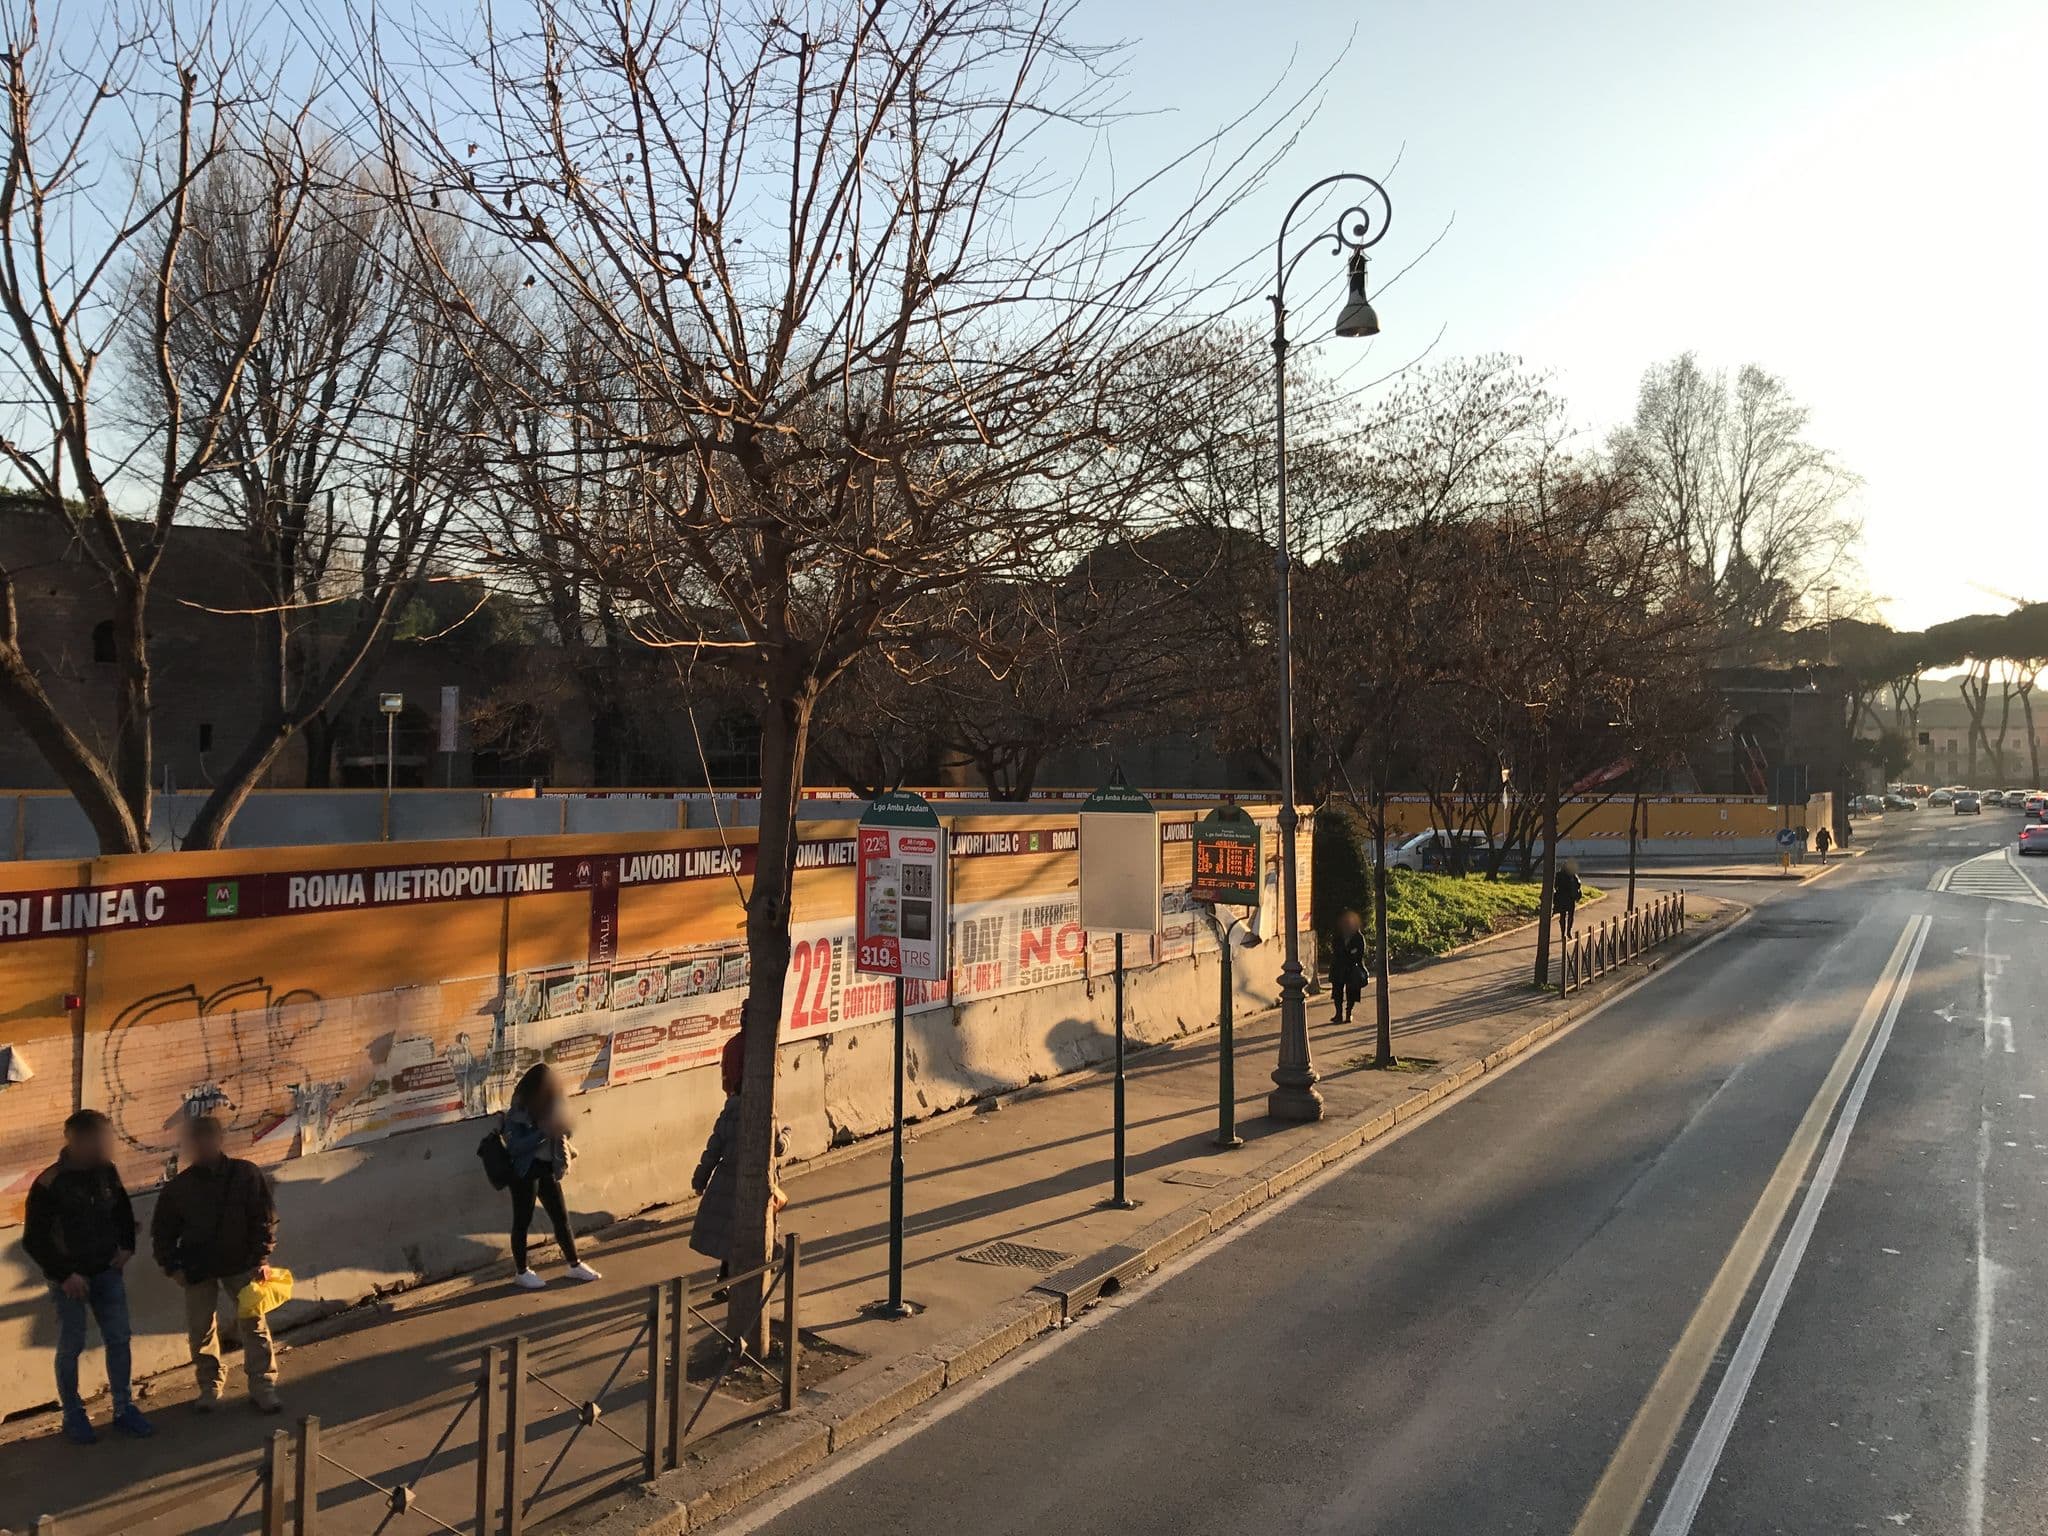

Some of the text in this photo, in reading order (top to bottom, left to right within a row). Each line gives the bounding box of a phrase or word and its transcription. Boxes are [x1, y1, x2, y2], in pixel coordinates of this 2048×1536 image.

[887, 803, 904, 811] Amba
[905, 804, 929, 812] Aradam
[949, 833, 1019, 855] LAVORI LINEA C
[1052, 830, 1076, 850] ROMA
[1163, 823, 1187, 840] LAVORI
[619, 852, 679, 883] LAVORI
[795, 843, 824, 867] OMA
[288, 862, 554, 908] ROMA METROPOLITANE
[42, 888, 139, 932] LINEA
[145, 886, 165, 921] C
[962, 916, 1004, 965] DAY
[1020, 919, 1085, 969] NO
[902, 950, 931, 966] TRIS
[790, 937, 831, 1030] 22
[830, 935, 843, 1023] OTTOBRE
[843, 983, 881, 1020] CORTEO
